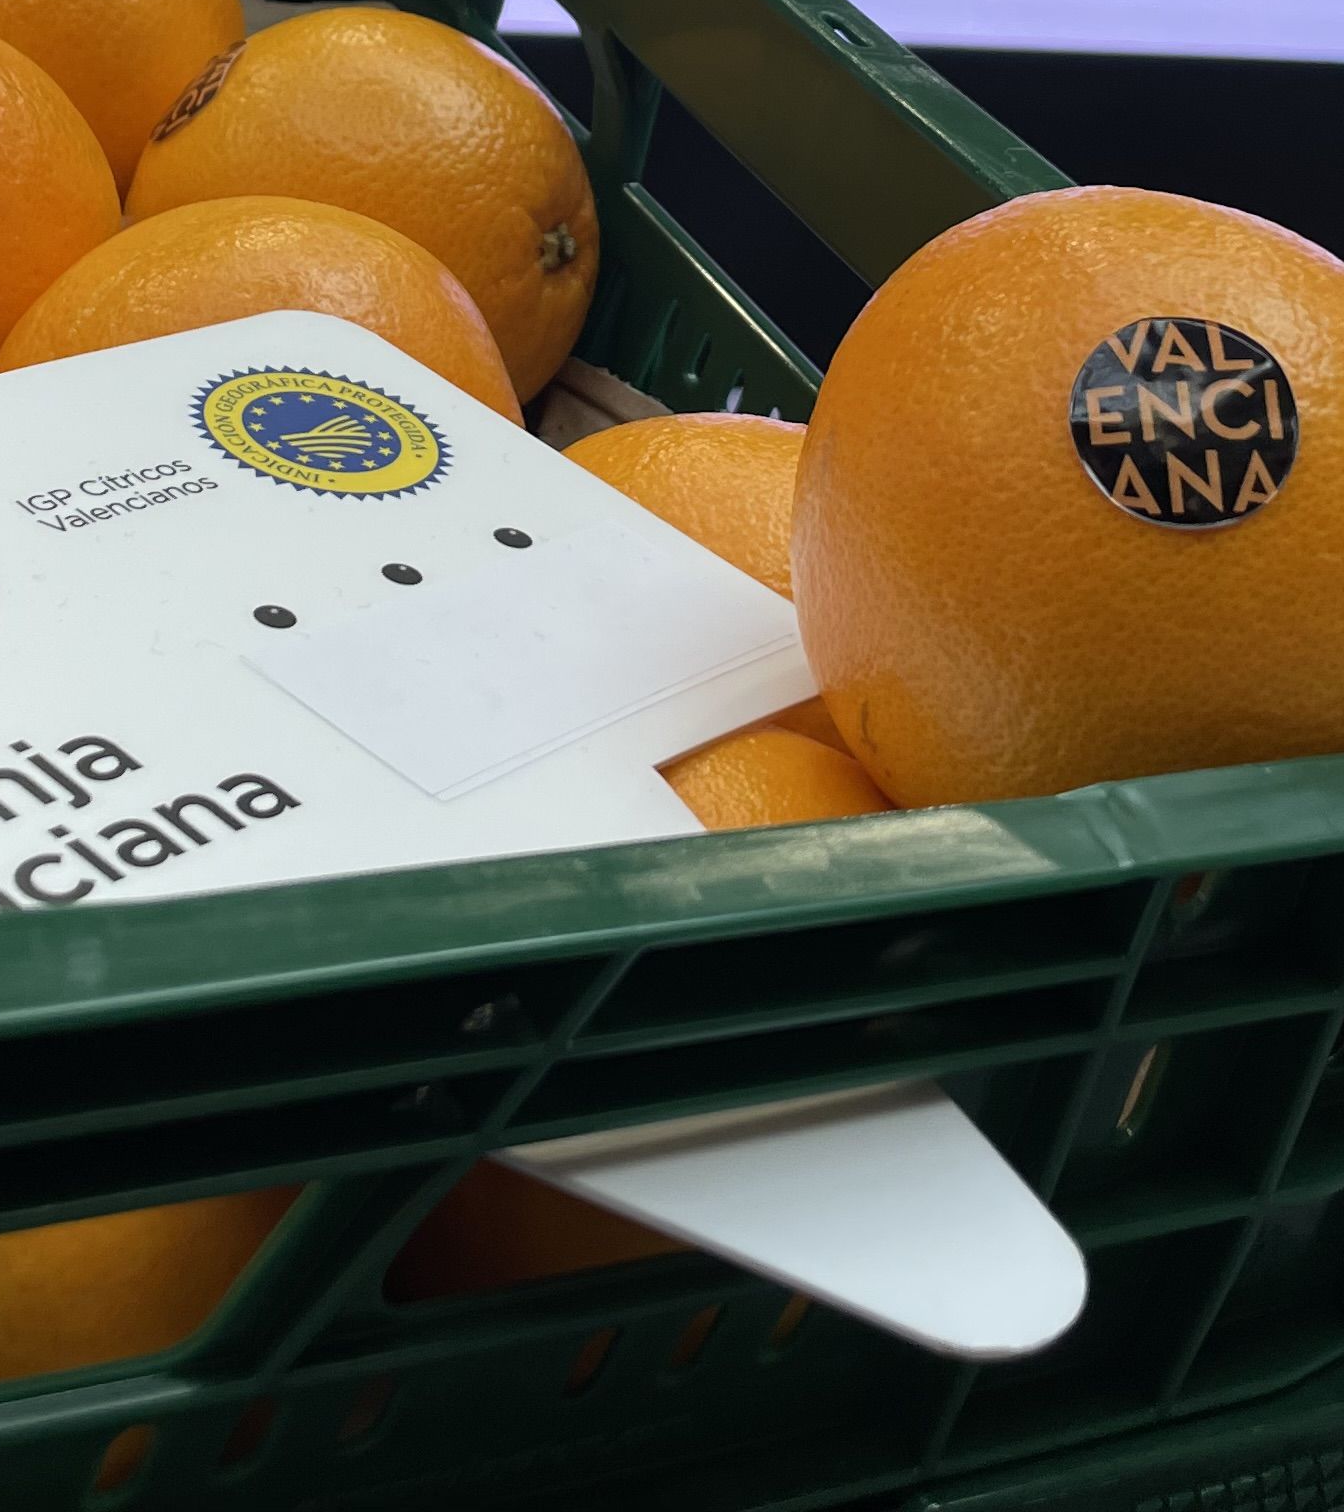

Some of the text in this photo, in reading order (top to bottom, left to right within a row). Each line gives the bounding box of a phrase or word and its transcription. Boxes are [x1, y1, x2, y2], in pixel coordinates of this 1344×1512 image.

[1106, 319, 1255, 375] VAL
[212, 413, 321, 484] INDICACIÓN
[338, 384, 428, 453] PROTEGIDA
[1085, 377, 1285, 446] ENCI
[15, 458, 193, 515] IGP Cítricos
[36, 476, 219, 533] Valencianos
[1112, 448, 1279, 516] ANA
